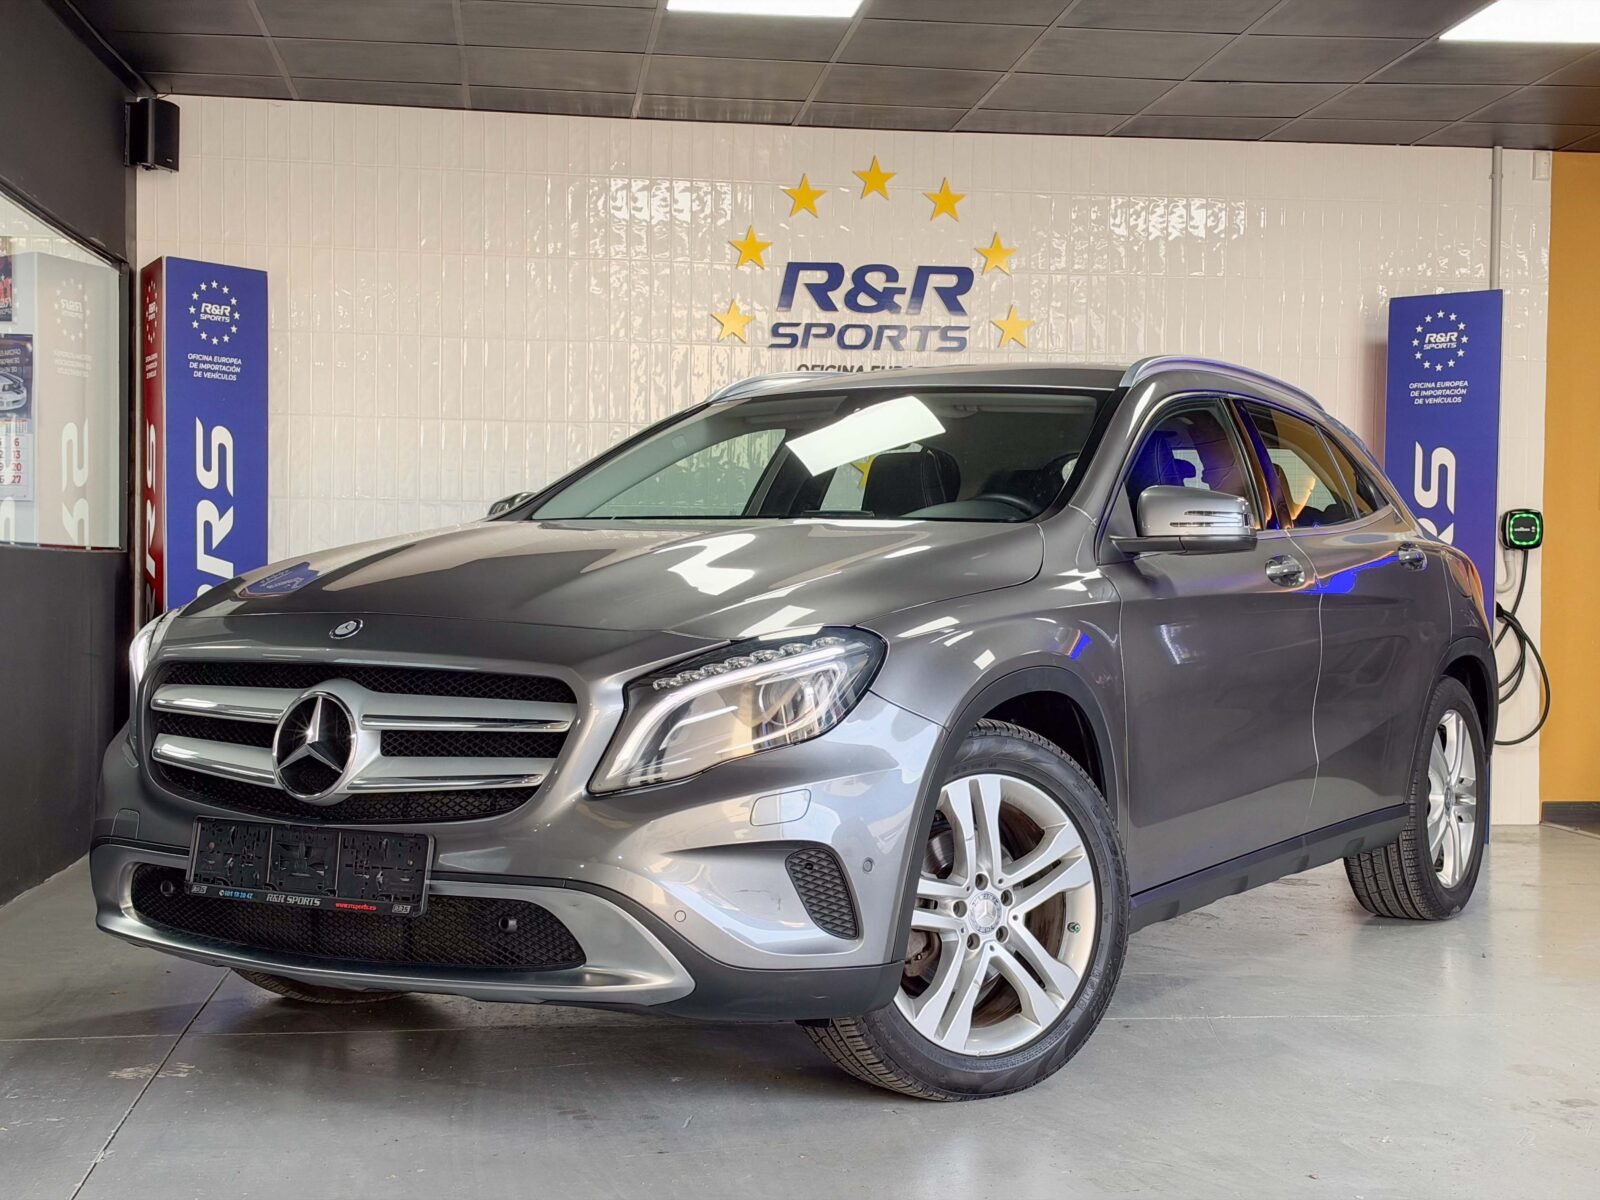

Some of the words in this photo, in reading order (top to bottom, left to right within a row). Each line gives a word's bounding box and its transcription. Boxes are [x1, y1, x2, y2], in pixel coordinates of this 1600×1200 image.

[776, 261, 975, 317] R&R
[200, 302, 231, 316] R&R
[199, 313, 231, 323] SPORTS
[767, 322, 971, 353] SPORTS
[1424, 331, 1458, 344] R&R
[1423, 341, 1457, 350] SPORTS
[187, 353, 213, 362] OFICINA
[213, 355, 242, 365] EUROPEA
[199, 362, 241, 373] IMPORTACIÓN
[203, 370, 237, 381] VEHÍCULOS
[1408, 381, 1436, 389] OFICINA
[1436, 380, 1469, 388] EUROPEA
[1410, 389, 1420, 397] DE
[1420, 387, 1467, 397] IMPORTACIÓN
[1414, 397, 1424, 405] DE
[1424, 396, 1462, 404] VEHÍCULOS
[11, 475, 22, 484] 27
[195, 416, 234, 602] RS
[266, 893, 286, 903] R&R
[285, 895, 321, 907] SPORTS
